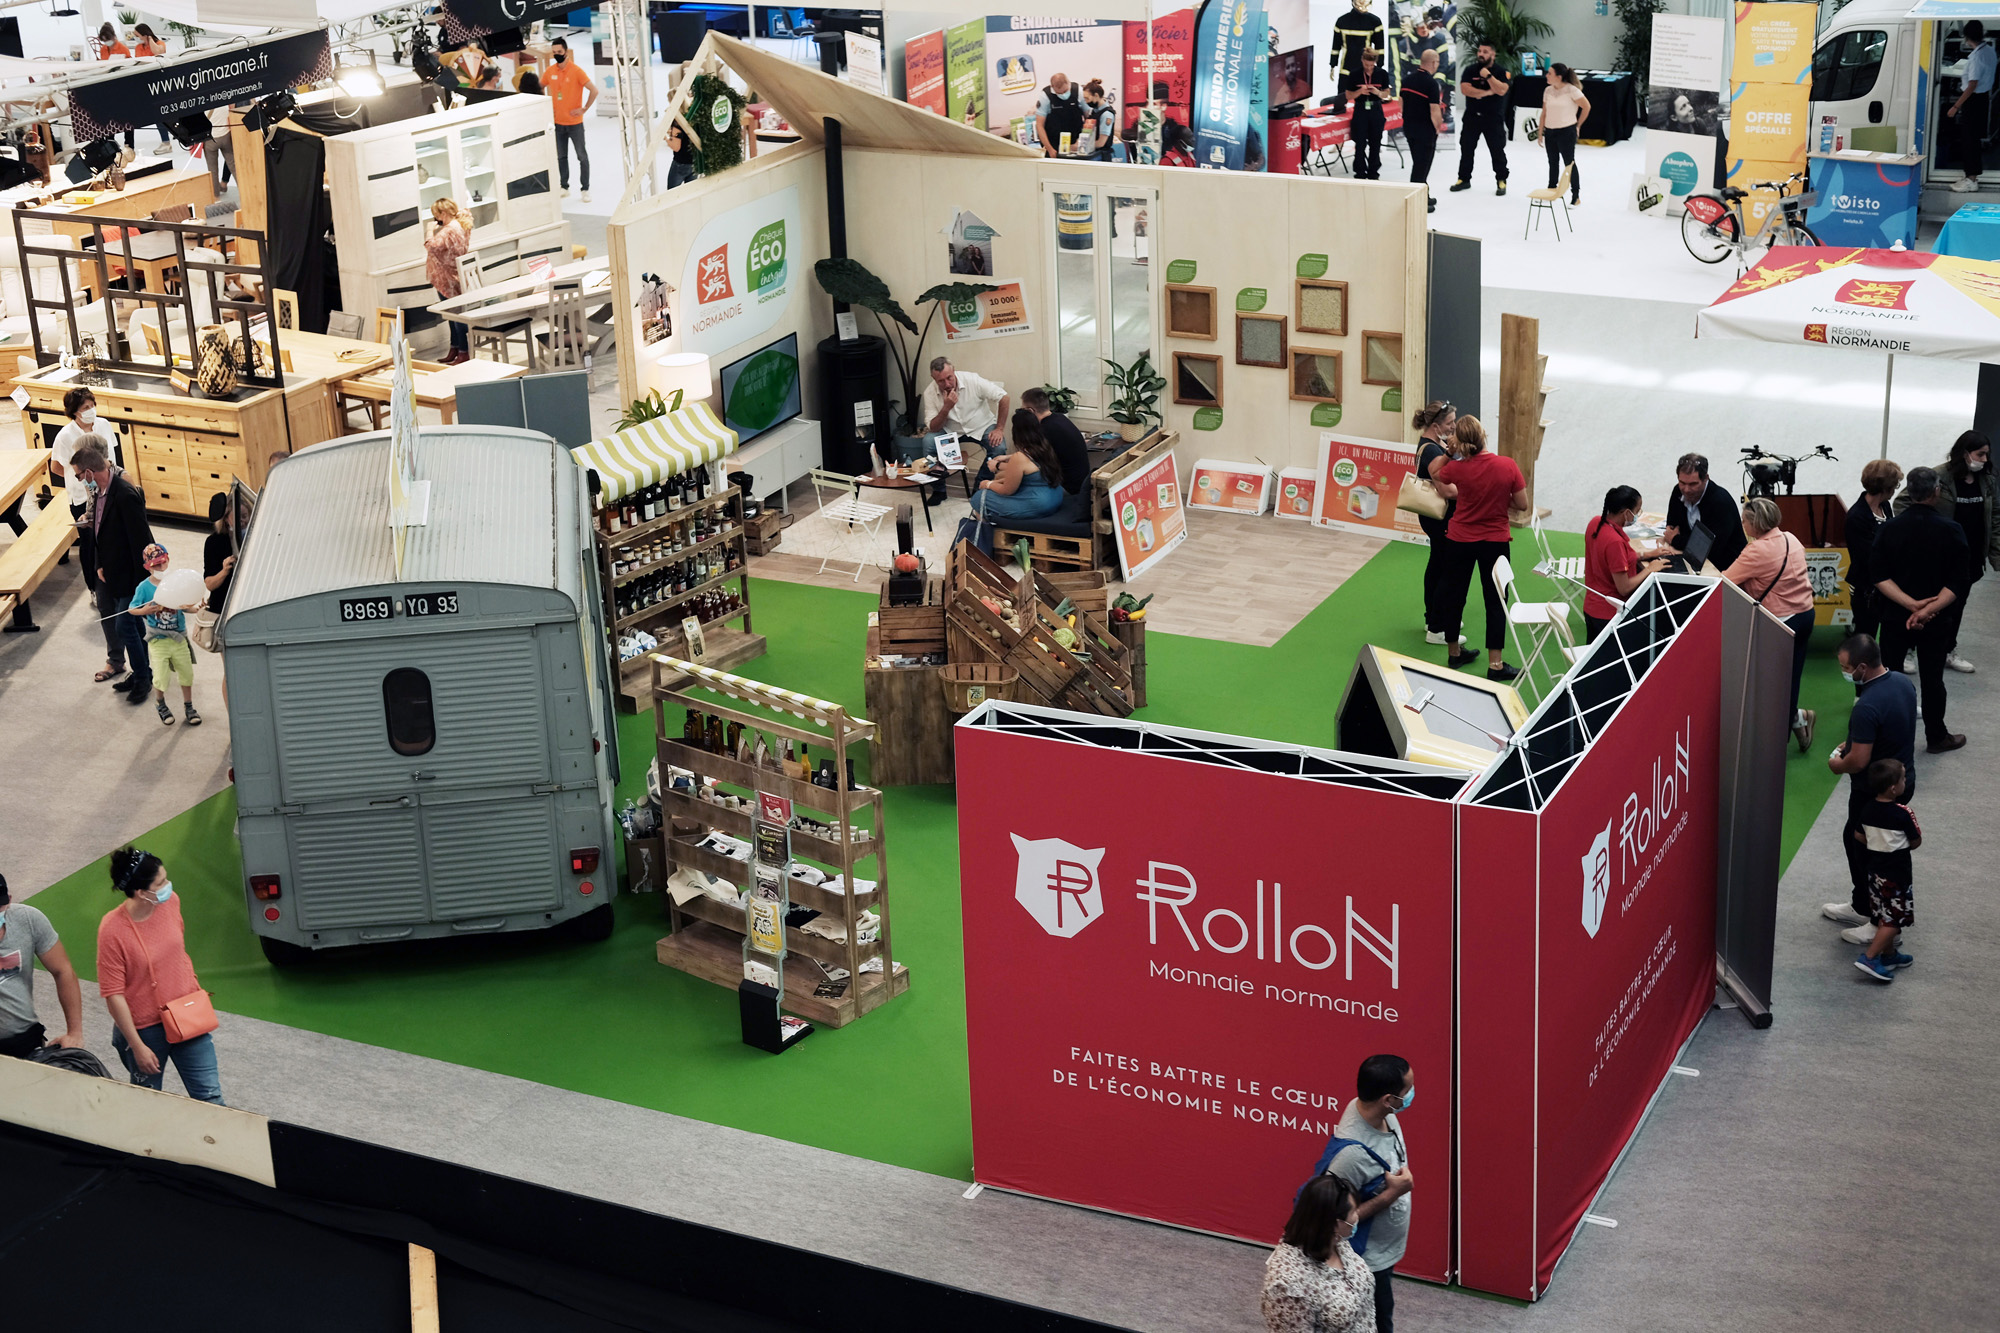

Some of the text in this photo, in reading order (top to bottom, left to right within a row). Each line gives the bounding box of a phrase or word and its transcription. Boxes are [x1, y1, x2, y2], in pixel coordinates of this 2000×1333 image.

[1026, 31, 1083, 45] NATIONALE
[148, 52, 268, 96] www.gimazane.fr
[1224, 39, 1243, 126] NATIONALE
[160, 105, 169, 114] 02
[170, 102, 178, 112] 33
[180, 101, 188, 110] 40
[188, 98, 196, 108] 07
[197, 96, 205, 106] 72
[210, 82, 263, 102] info@gimazane.fr
[1746, 111, 1792, 124] OFFRE
[1745, 125, 1786, 135] SPÉCIALE
[1831, 194, 1880, 210] twisto
[759, 227, 784, 244] Chèque
[750, 240, 782, 271] ÉCO
[757, 287, 787, 305] NORMANDIE
[989, 298, 999, 306] 10
[950, 301, 975, 315] ÉCO
[990, 311, 1017, 319] Emmanuelle
[1811, 306, 1921, 321] NORMANDIE
[692, 303, 743, 335] NORMANDIE
[997, 316, 1020, 324] Christophe
[1831, 326, 1872, 337] RÉGION
[1831, 336, 1911, 351] NORMANDIE
[1352, 448, 1360, 458] UN
[1362, 449, 1381, 461] PROJET
[1384, 452, 1391, 463] DE
[1133, 480, 1144, 495] PROJET
[344, 596, 457, 620] 8969 YQ 93
[1620, 811, 1689, 917] Monnaie normande
[1150, 960, 1399, 1022] Monnaie normande
[1595, 924, 1673, 1052] FAITES BATTRE LE CŒUR
[1588, 939, 1677, 1087] DE L'ÉCONOMIE NORMANDE
[1071, 1046, 1339, 1112] FAITES BATTRE LE CŒUR
[1053, 1069, 1078, 1087] DE
[1088, 1074, 1222, 1114] L'ÉCONOMIE
